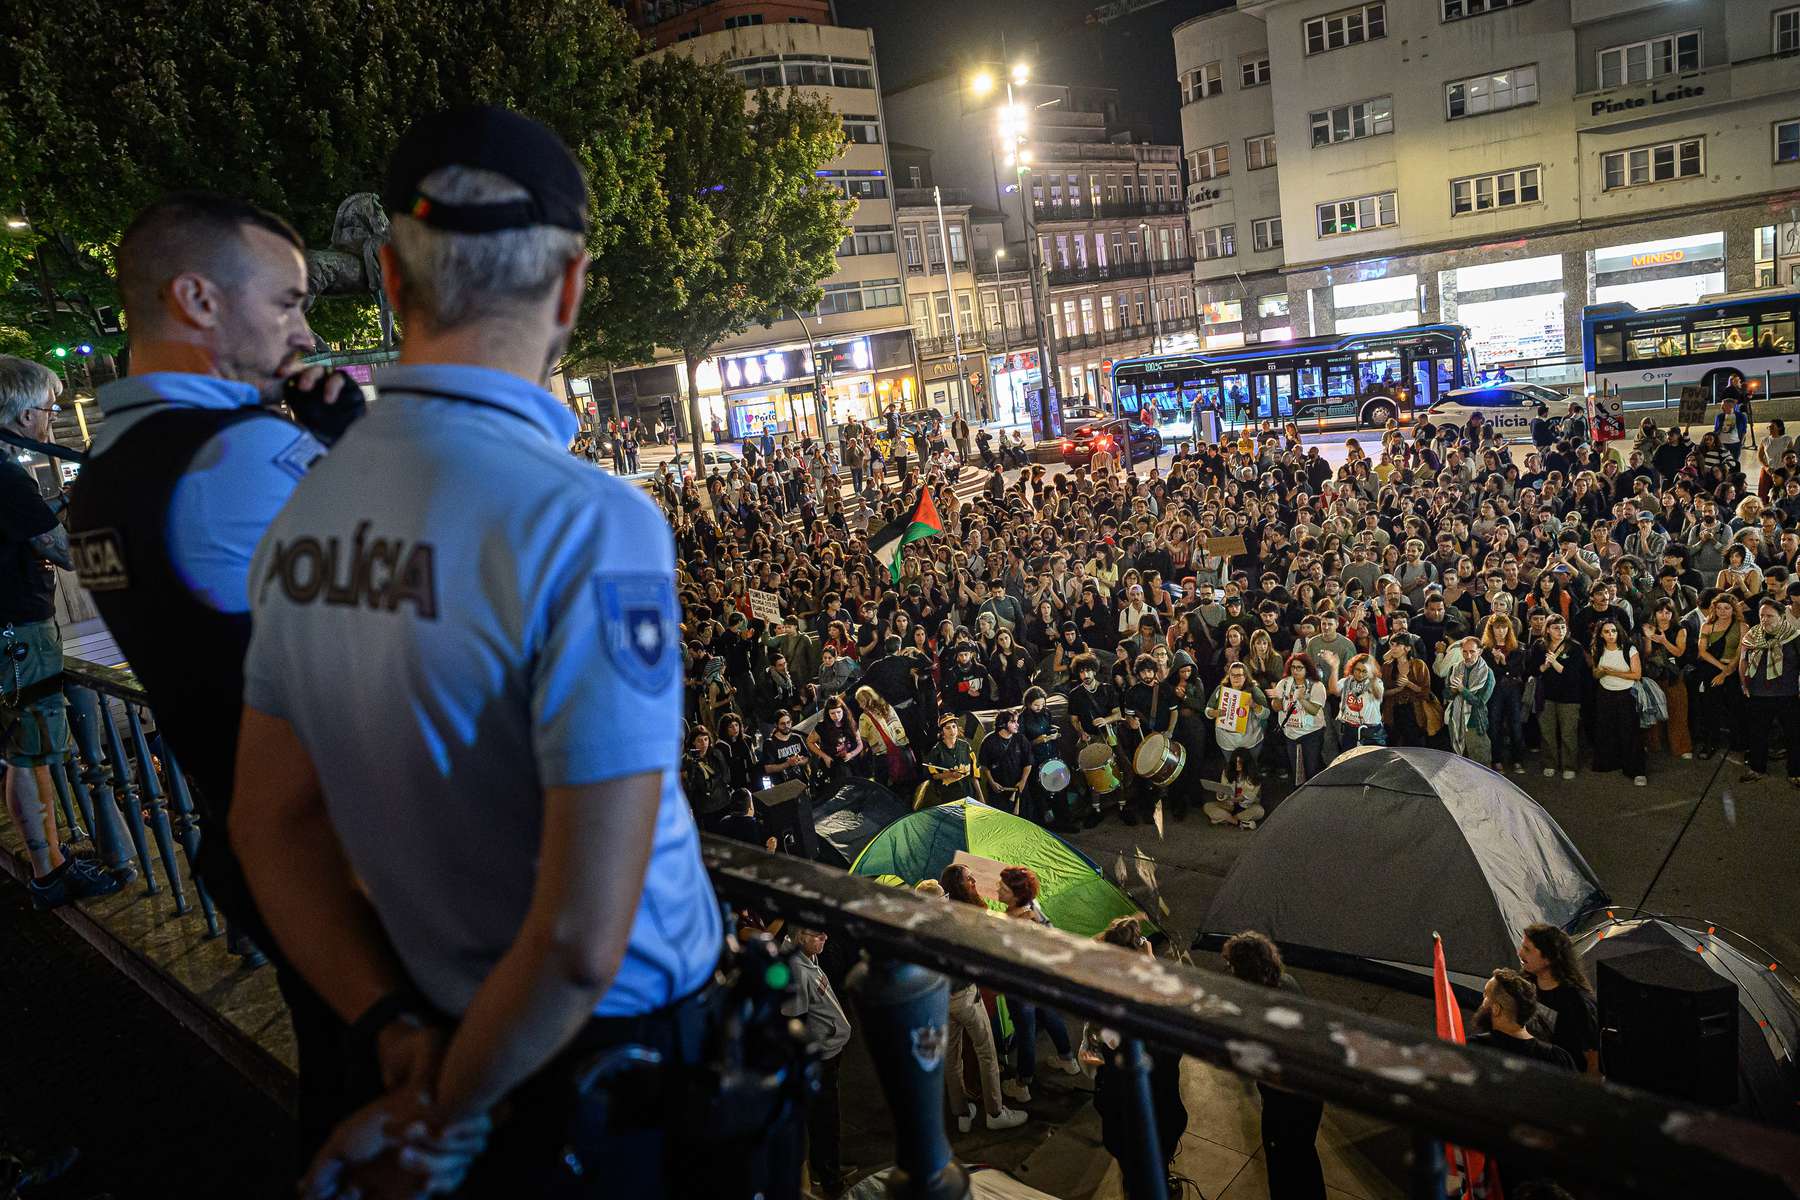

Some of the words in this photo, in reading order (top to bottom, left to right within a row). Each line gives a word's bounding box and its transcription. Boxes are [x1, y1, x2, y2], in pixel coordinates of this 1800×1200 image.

[1591, 98, 1646, 117] Pinto
[1651, 85, 1705, 104] Leite
[1632, 249, 1685, 267] MINISO
[1486, 414, 1531, 428] olícia.
